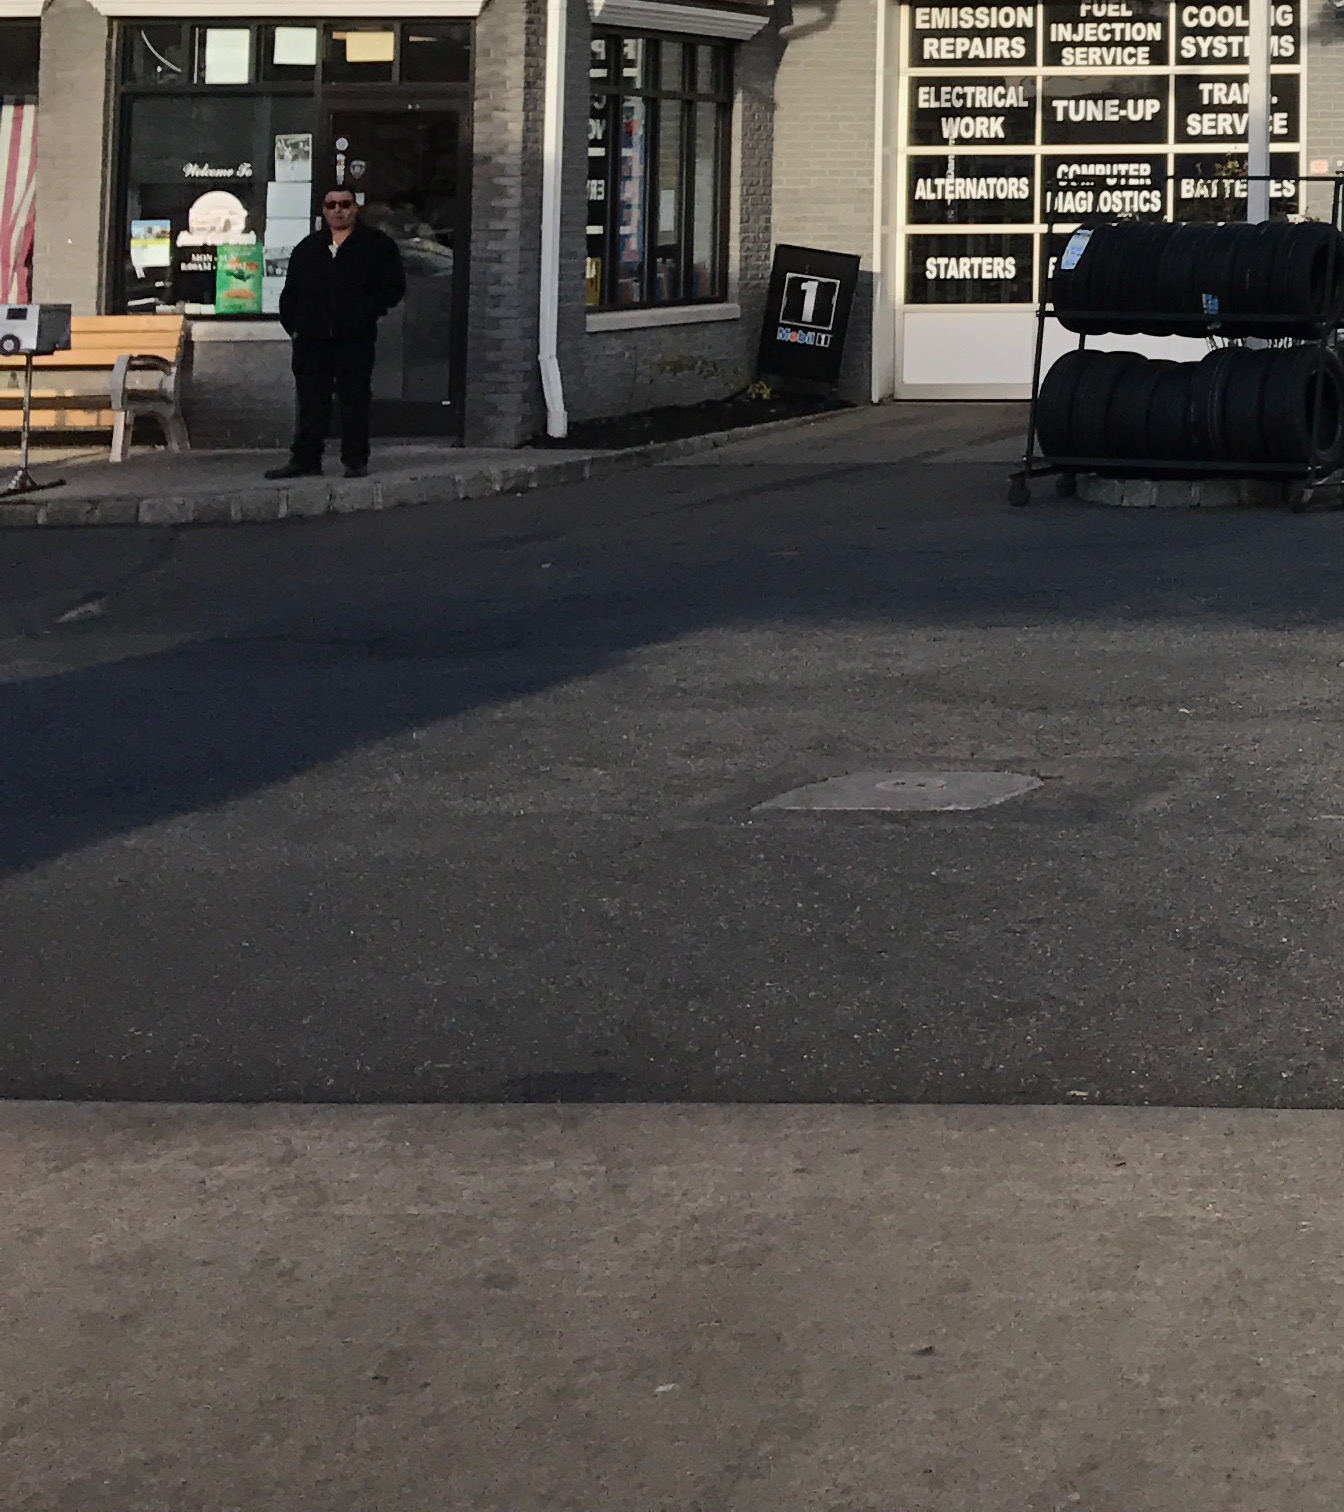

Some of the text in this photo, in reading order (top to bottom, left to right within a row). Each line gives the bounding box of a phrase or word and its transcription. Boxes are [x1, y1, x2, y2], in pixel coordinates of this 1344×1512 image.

[915, 6, 1034, 29] EMISSION
[1080, 0, 1133, 17] FUEL
[1182, 5, 1294, 28] COOLG
[1050, 22, 1162, 42] INJECTION
[923, 37, 1026, 59] REPAIRS
[1061, 47, 1150, 66] SERVICE
[918, 85, 1029, 108] ELECTRICAL
[1052, 99, 1161, 121] TUNE-UP
[941, 116, 1006, 138] WORK
[1186, 113, 1288, 135] SERVE
[183, 161, 253, 178] Welcome To
[1057, 163, 1151, 186] COMPUTER
[914, 177, 1029, 200] ALTERNATORS
[1180, 178, 1296, 199] BATTEES
[925, 256, 1016, 279] STARTERS
[801, 280, 819, 322] 1
[777, 327, 816, 345] Mobil
